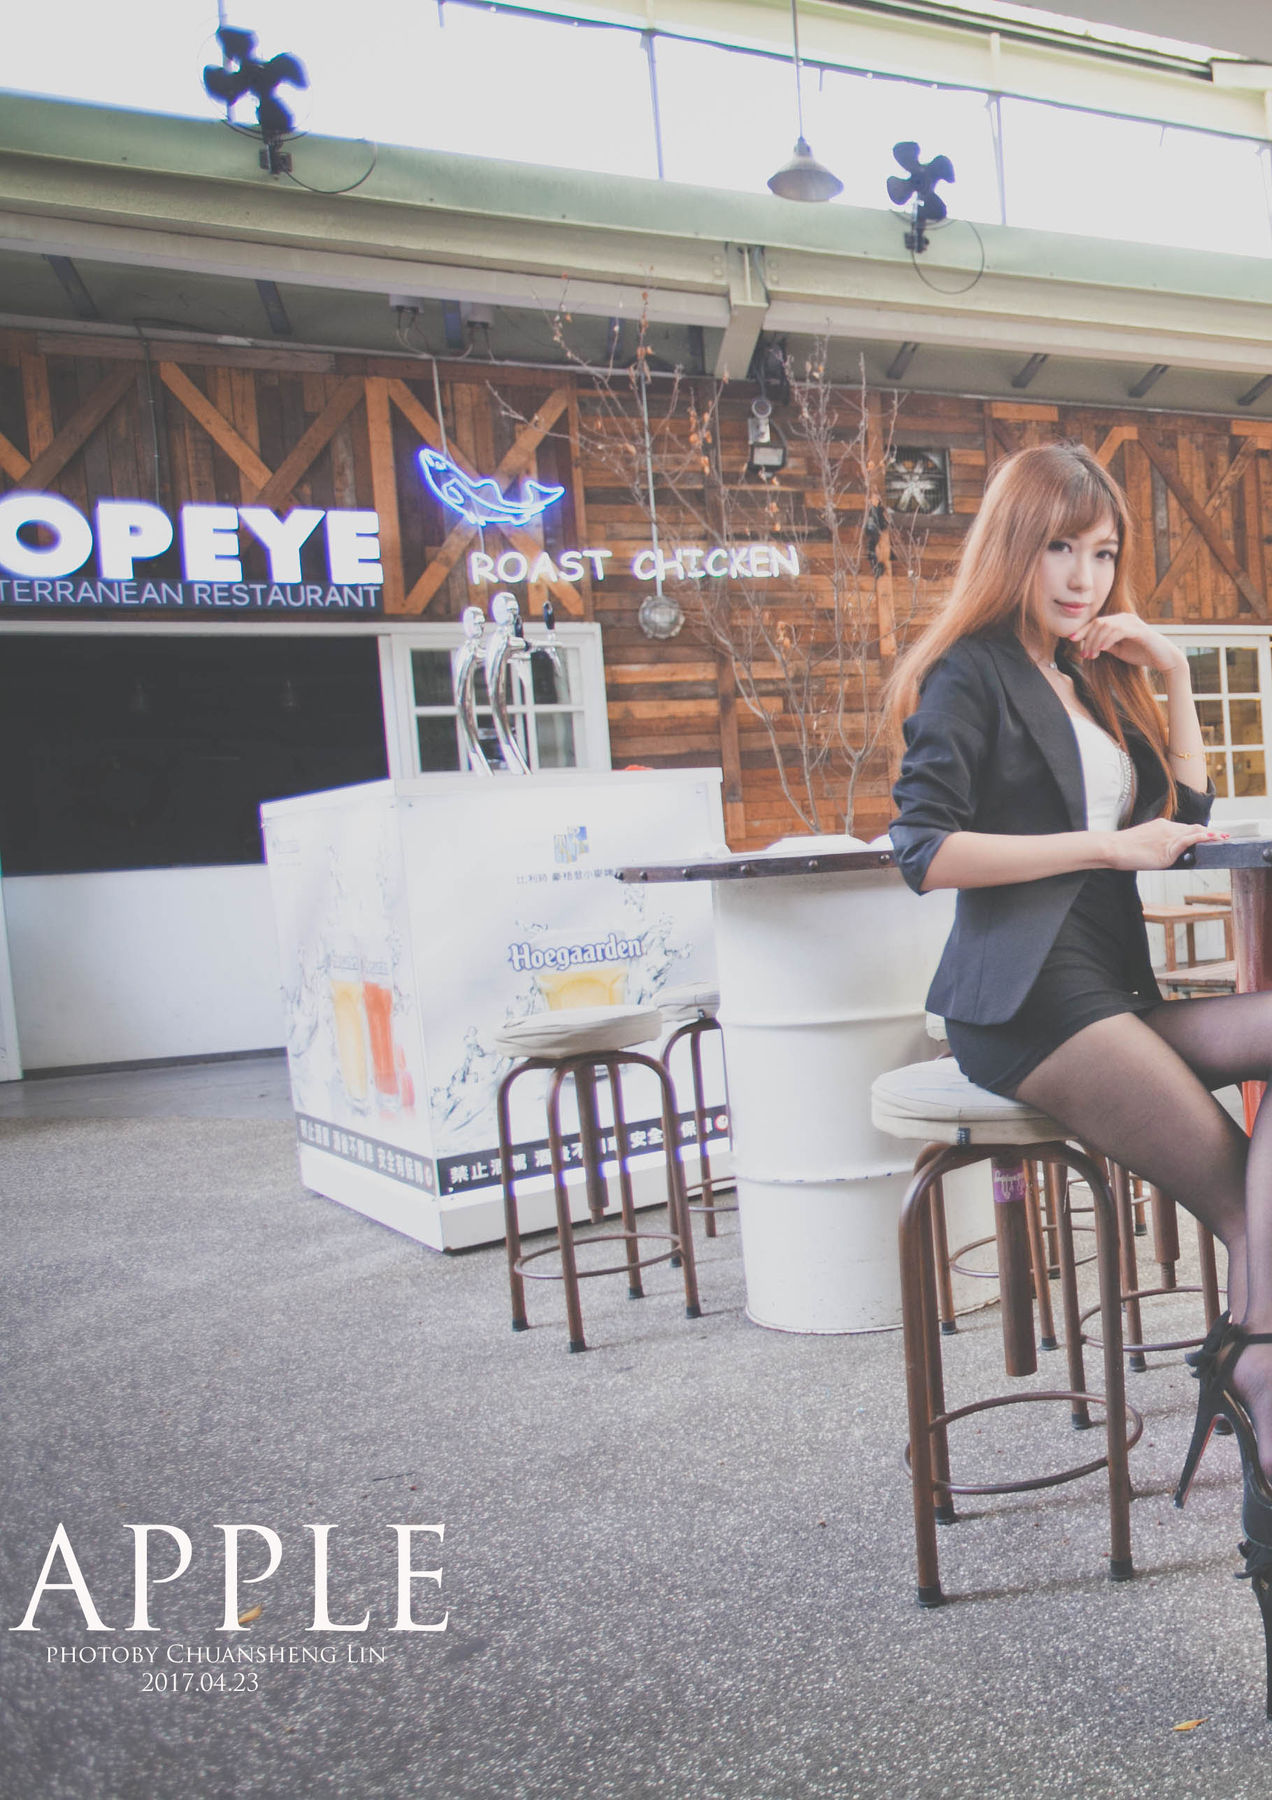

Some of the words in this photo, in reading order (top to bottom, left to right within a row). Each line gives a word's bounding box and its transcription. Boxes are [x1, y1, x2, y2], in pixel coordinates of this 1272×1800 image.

[470, 549, 612, 584] ROAST
[632, 545, 800, 580] CHICKEN
[193, 583, 381, 607] RESTAURANT
[507, 932, 643, 972] Hoegaarden
